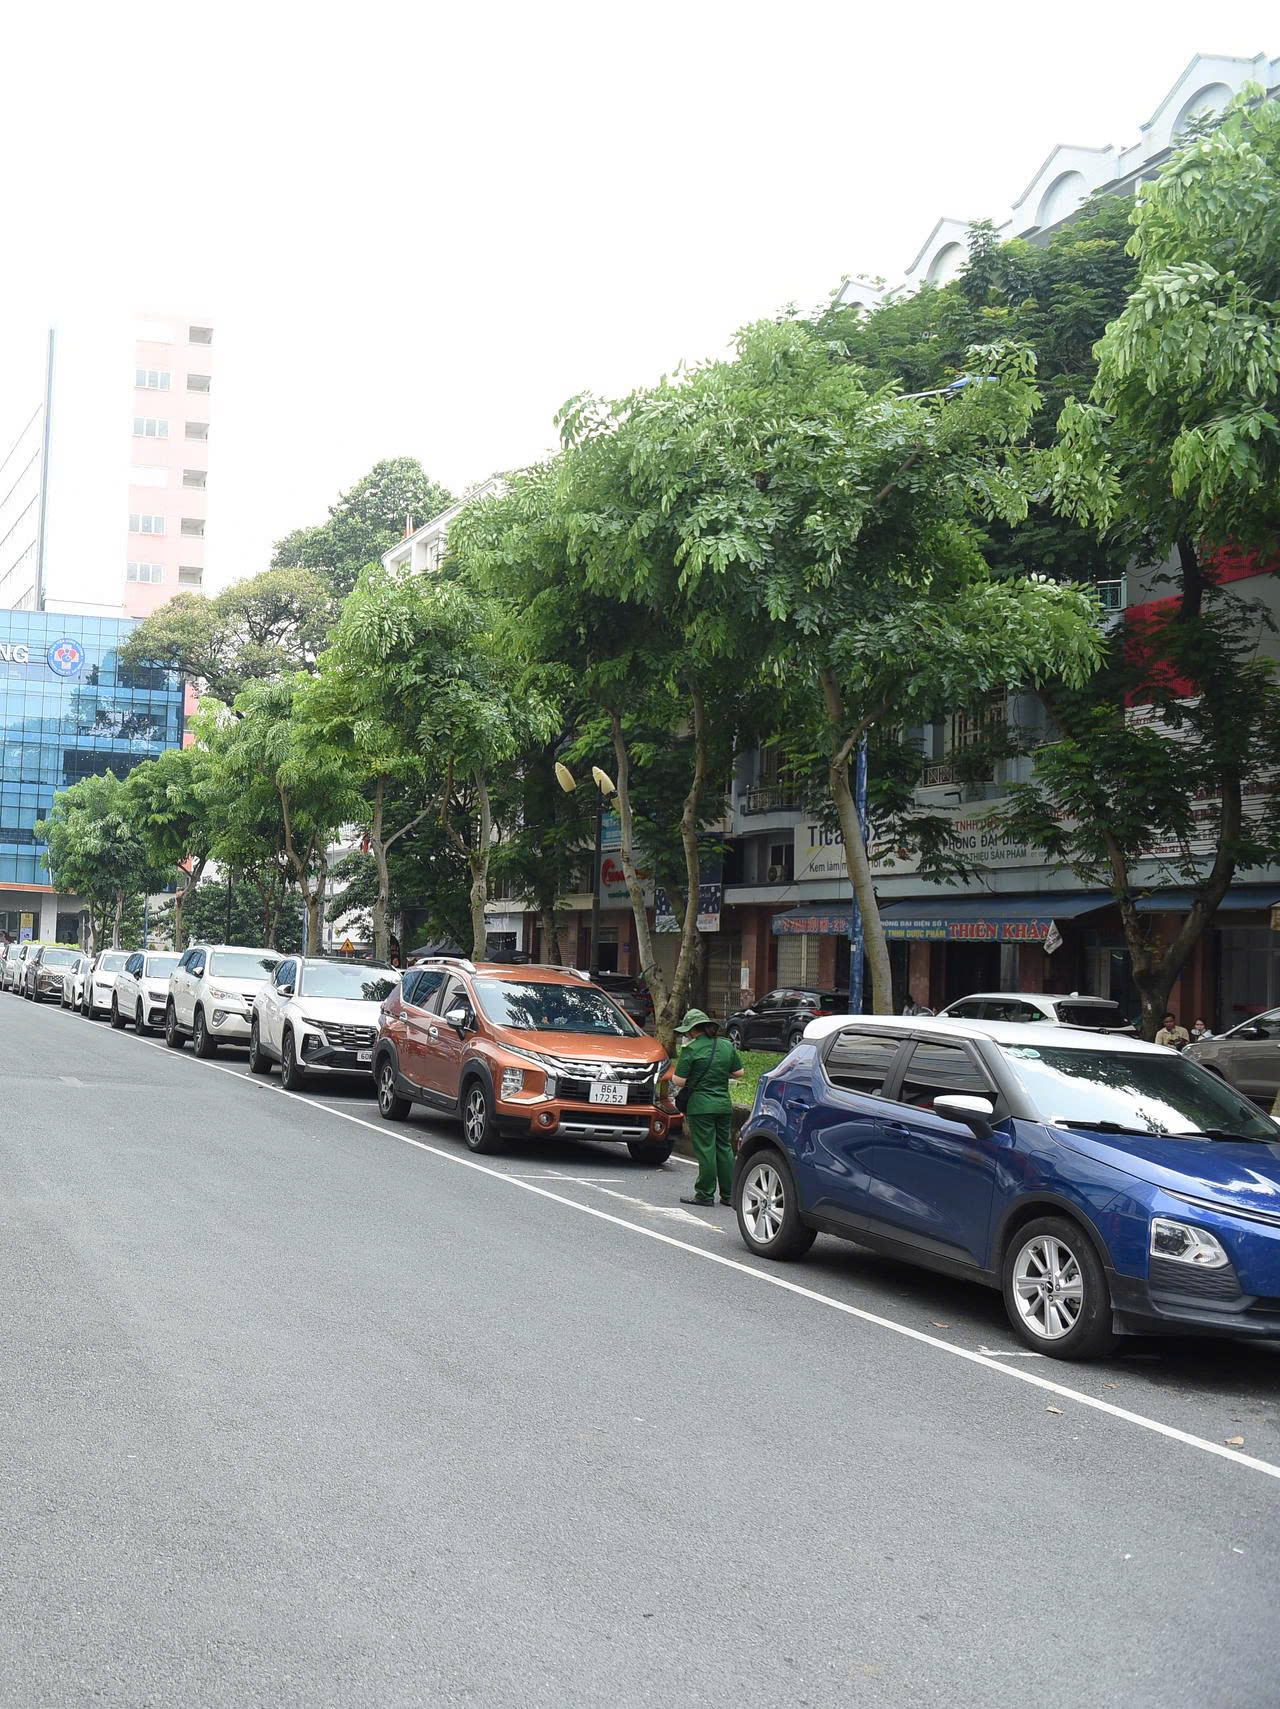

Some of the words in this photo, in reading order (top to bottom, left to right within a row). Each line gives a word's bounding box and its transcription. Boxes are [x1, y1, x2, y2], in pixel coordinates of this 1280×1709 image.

[981, 834, 998, 850] ĐẠI
[809, 863, 826, 873] Kem
[826, 861, 840, 871] làm
[1001, 918, 1051, 939] KHÁN
[600, 1084, 617, 1094] 86A
[594, 1094, 623, 1103] 172.52
